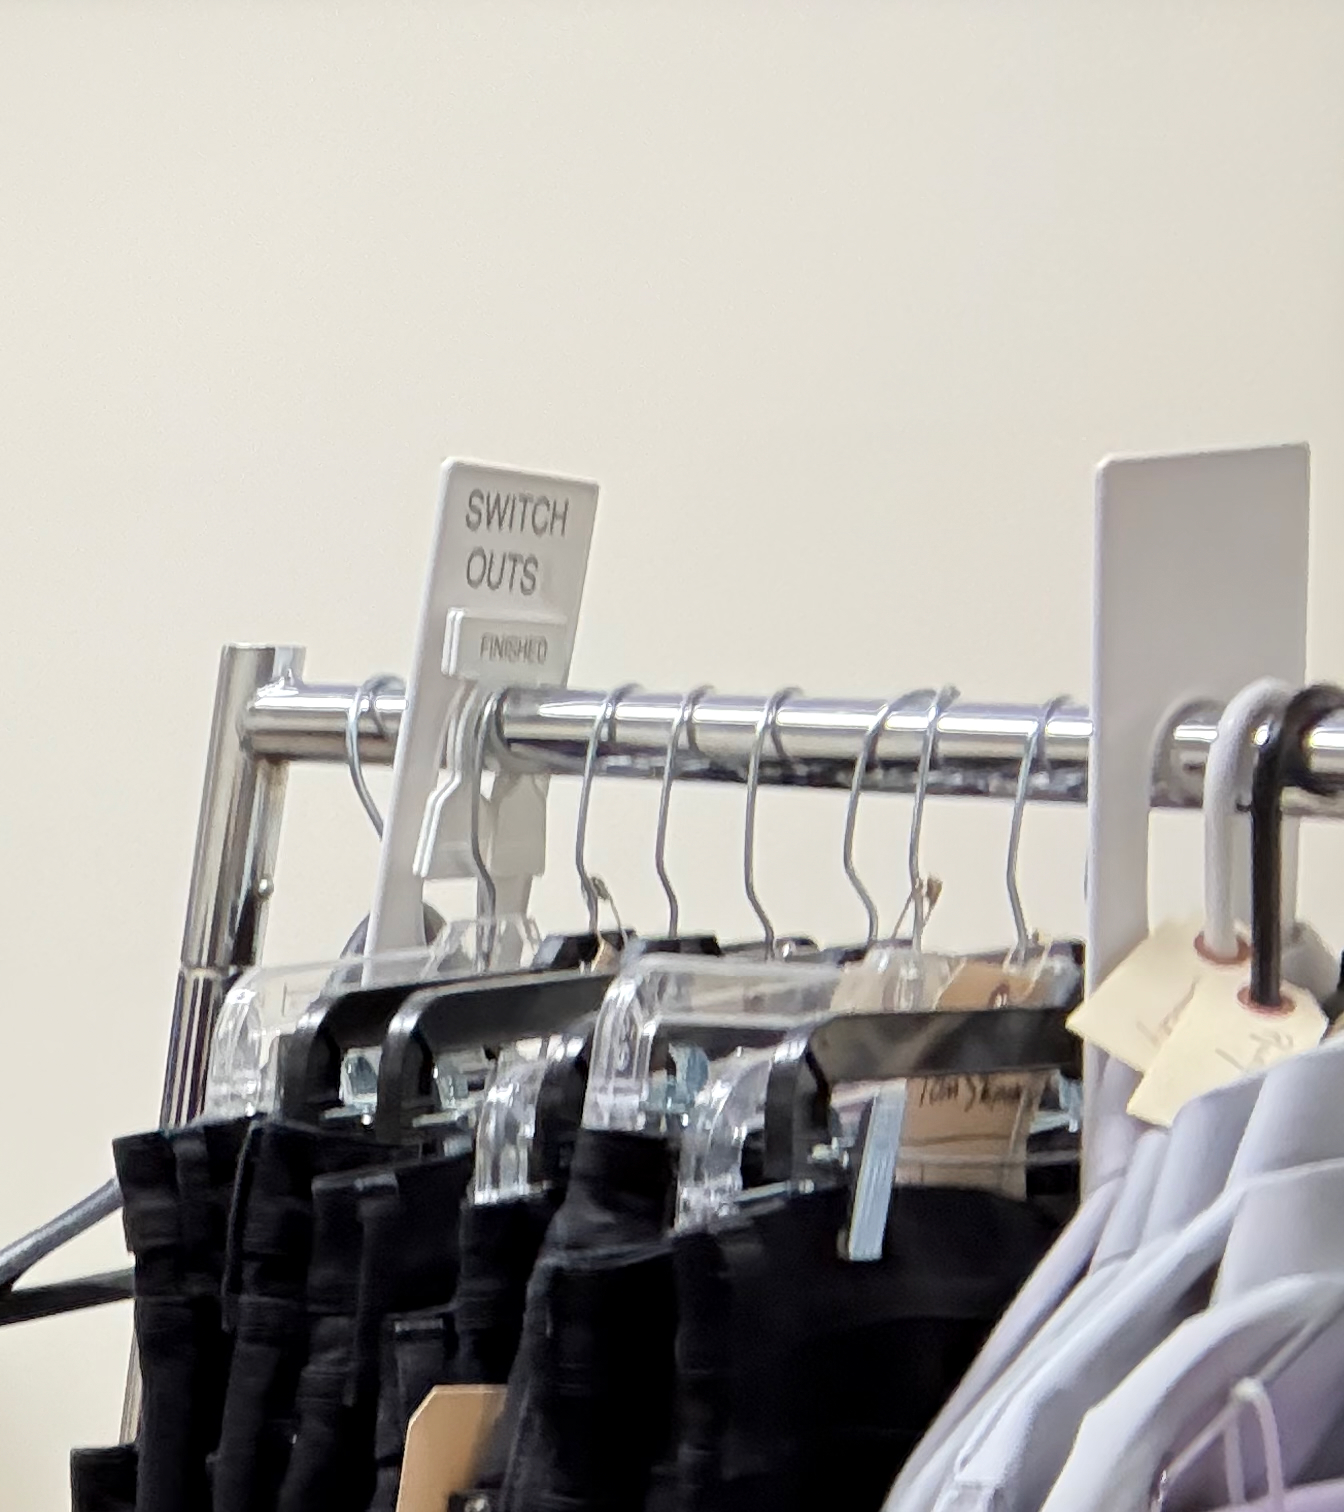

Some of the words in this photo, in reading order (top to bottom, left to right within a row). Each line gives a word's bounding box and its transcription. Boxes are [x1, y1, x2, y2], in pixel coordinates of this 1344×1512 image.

[465, 488, 569, 537] SWITCH
[466, 546, 538, 596] OUTS
[479, 631, 549, 664] FINISHED
